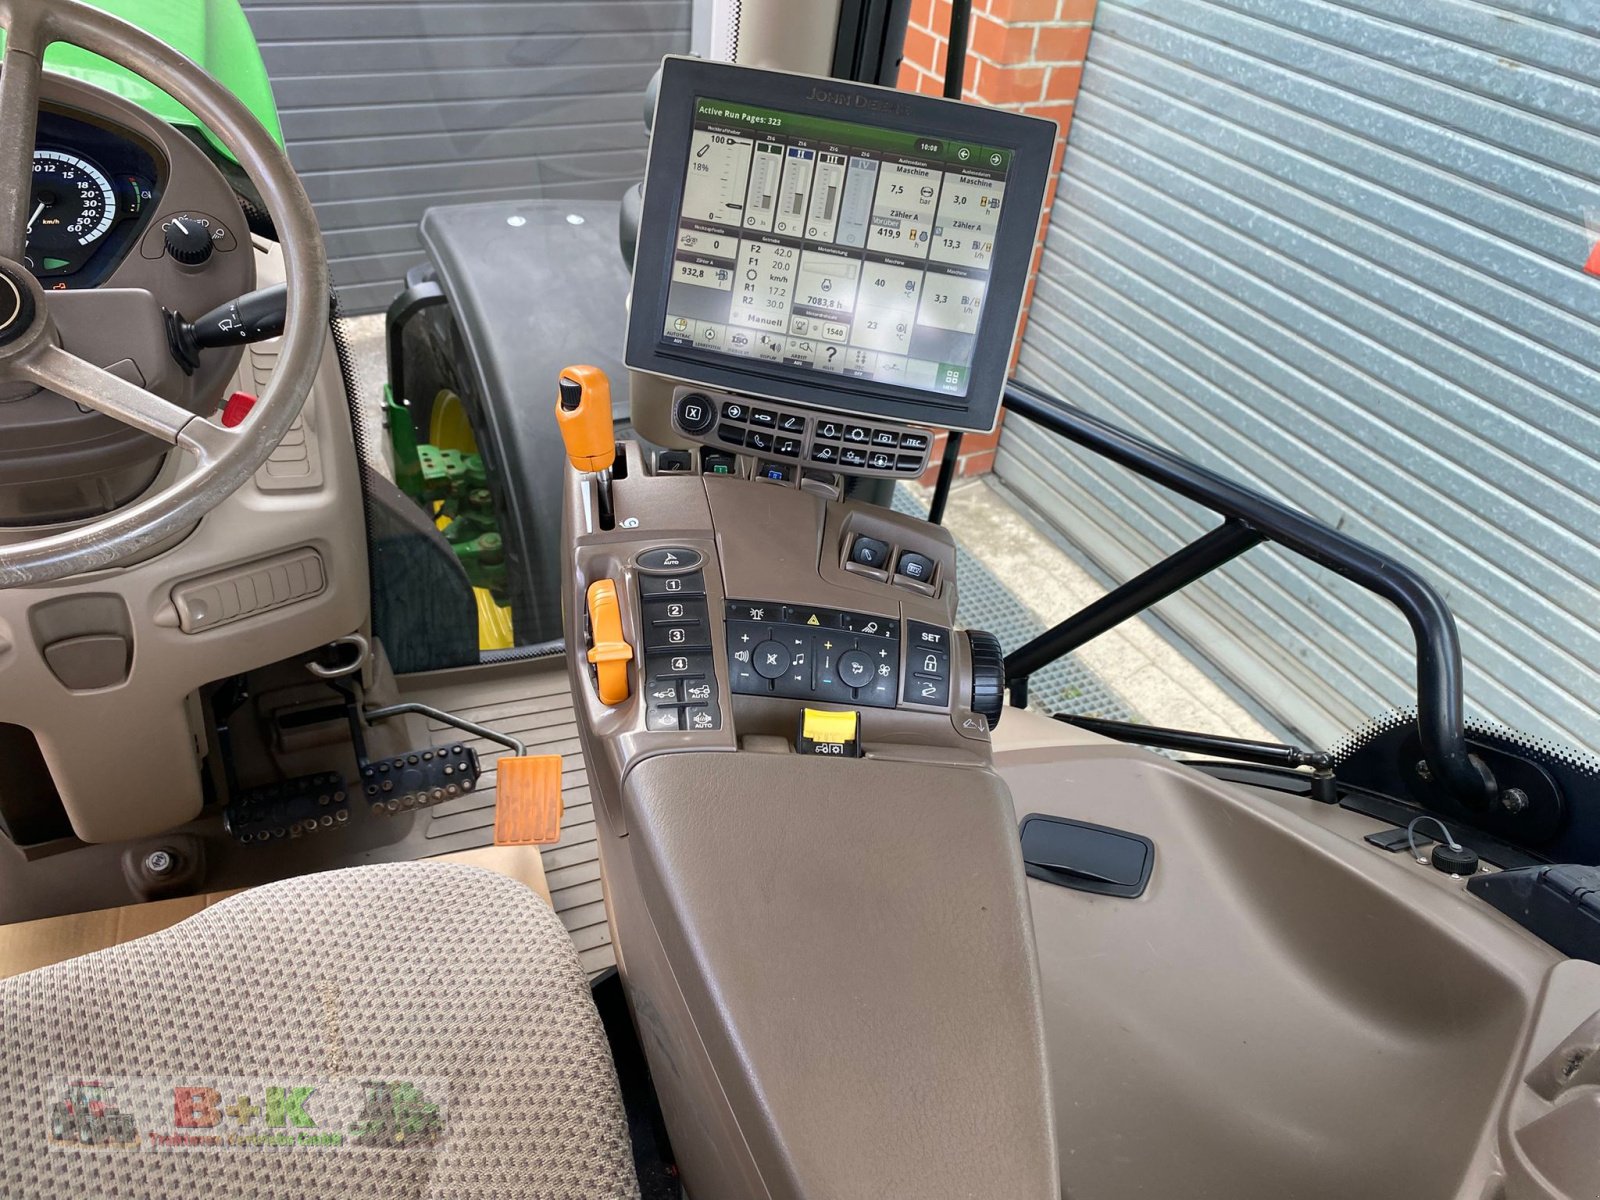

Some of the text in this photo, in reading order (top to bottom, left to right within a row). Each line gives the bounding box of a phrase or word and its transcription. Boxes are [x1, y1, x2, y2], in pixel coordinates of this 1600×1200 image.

[699, 105, 782, 127] Active Run Pages: 323
[711, 135, 725, 145] 100
[43, 164, 56, 173] 12
[692, 162, 710, 173] 18%
[896, 165, 929, 177] Maschine
[62, 171, 75, 179] 15
[76, 181, 89, 189] 18
[959, 176, 993, 189] Maschine
[80, 190, 95, 198] 20
[890, 184, 904, 195] 7,5
[919, 197, 931, 206] bar
[953, 195, 967, 205] 3,0
[81, 209, 96, 217] 40
[708, 212, 714, 220] 0
[890, 209, 919, 222] Zähler A
[76, 217, 91, 225] 50
[952, 220, 982, 232] Zähler A
[66, 224, 83, 233] 60
[877, 227, 901, 239] 419,9
[713, 240, 720, 249] 0
[943, 238, 961, 250] 13,3
[750, 244, 792, 258] F2 42.0
[748, 257, 790, 271] F1 20.0
[681, 266, 705, 279] 932,8
[769, 273, 788, 284] km/h
[875, 278, 886, 287] 40
[745, 283, 786, 297] R1 17.2
[742, 296, 784, 310] R2 30.0
[807, 295, 835, 308] 7083,8
[934, 294, 948, 304] 3,3
[747, 314, 783, 327] Manuell
[867, 320, 878, 329] 23
[826, 327, 844, 337] 1540
[731, 335, 749, 345] ISO
[689, 408, 698, 418] X
[670, 581, 677, 590] 1
[671, 606, 680, 615] 2
[673, 631, 681, 641] 3
[921, 632, 941, 643] SET
[675, 659, 684, 668] 4
